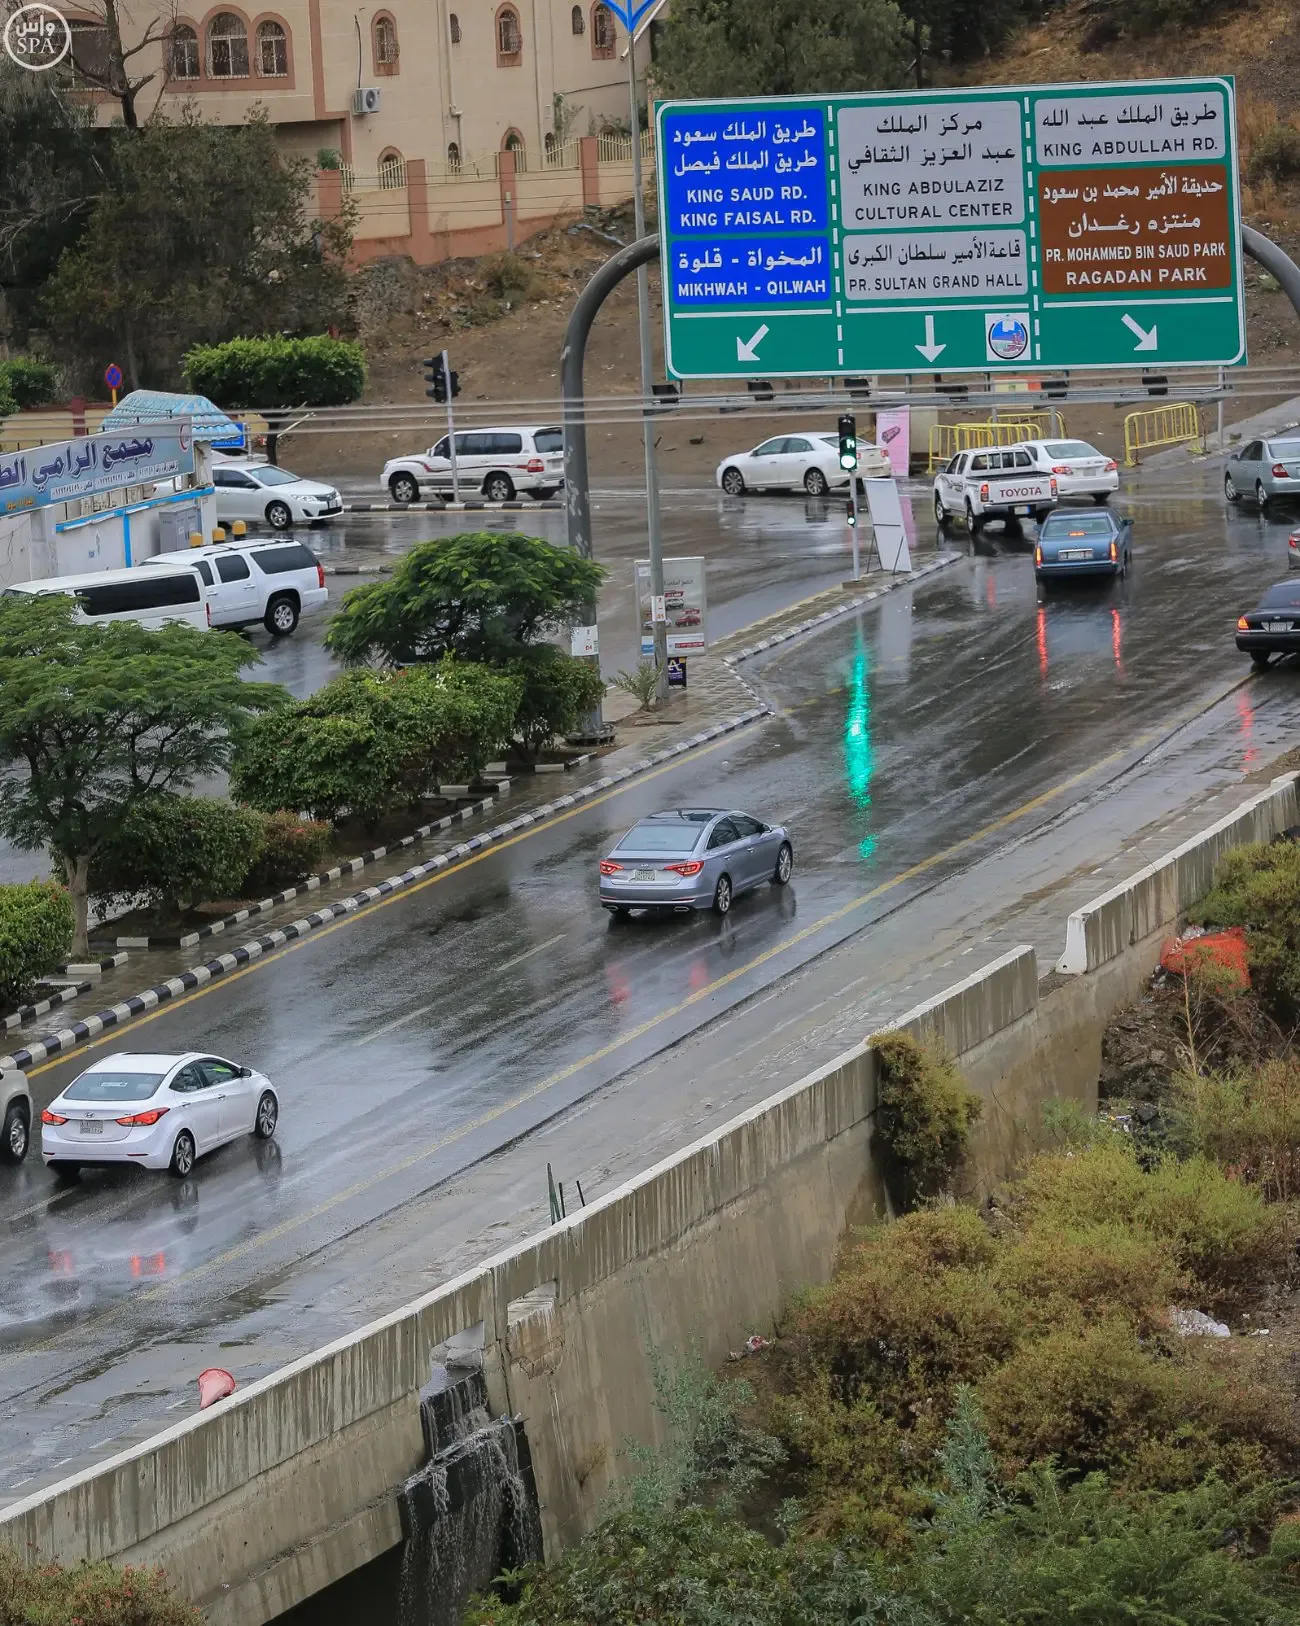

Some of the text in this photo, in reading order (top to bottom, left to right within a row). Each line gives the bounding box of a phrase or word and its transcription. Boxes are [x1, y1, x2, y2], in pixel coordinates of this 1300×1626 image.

[876, 113, 982, 136] مركز الملك
[1042, 101, 1217, 130] طريق الملك عبد الله
[673, 119, 816, 147] طريق الملك سعود
[1043, 137, 1218, 156] KING ABDULLAH RD.
[674, 149, 818, 177] طريق الملك فيصل
[848, 143, 1016, 175] عبد العزيز الثقافي
[687, 186, 808, 204] KING SAUD RD.
[863, 179, 1005, 197] KING ABDULAZIZ
[1043, 172, 1223, 205] حديقة الأمير محمد بن سعود
[680, 209, 817, 227] KING FAISAL RD.
[855, 202, 1013, 221] CULTURAL CENTER
[1147, 213, 1201, 234] منتزه
[679, 247, 723, 273] قلوة
[747, 246, 822, 271] المخواة
[848, 236, 1021, 268] قاعة الأمير سلطان الكبرى
[1046, 242, 1226, 262] PR. MOHAMMED BIN SAUD PARK
[849, 273, 1023, 292] PR. SULTAN GRAND HALL
[1066, 267, 1207, 285] RAGADAN PARK
[678, 282, 748, 297] MIKHWAH
[766, 280, 826, 295] QILWAH
[102, 436, 155, 471] مجمع
[32, 440, 100, 493] الرامي
[1000, 487, 1042, 498] TOYOTA
